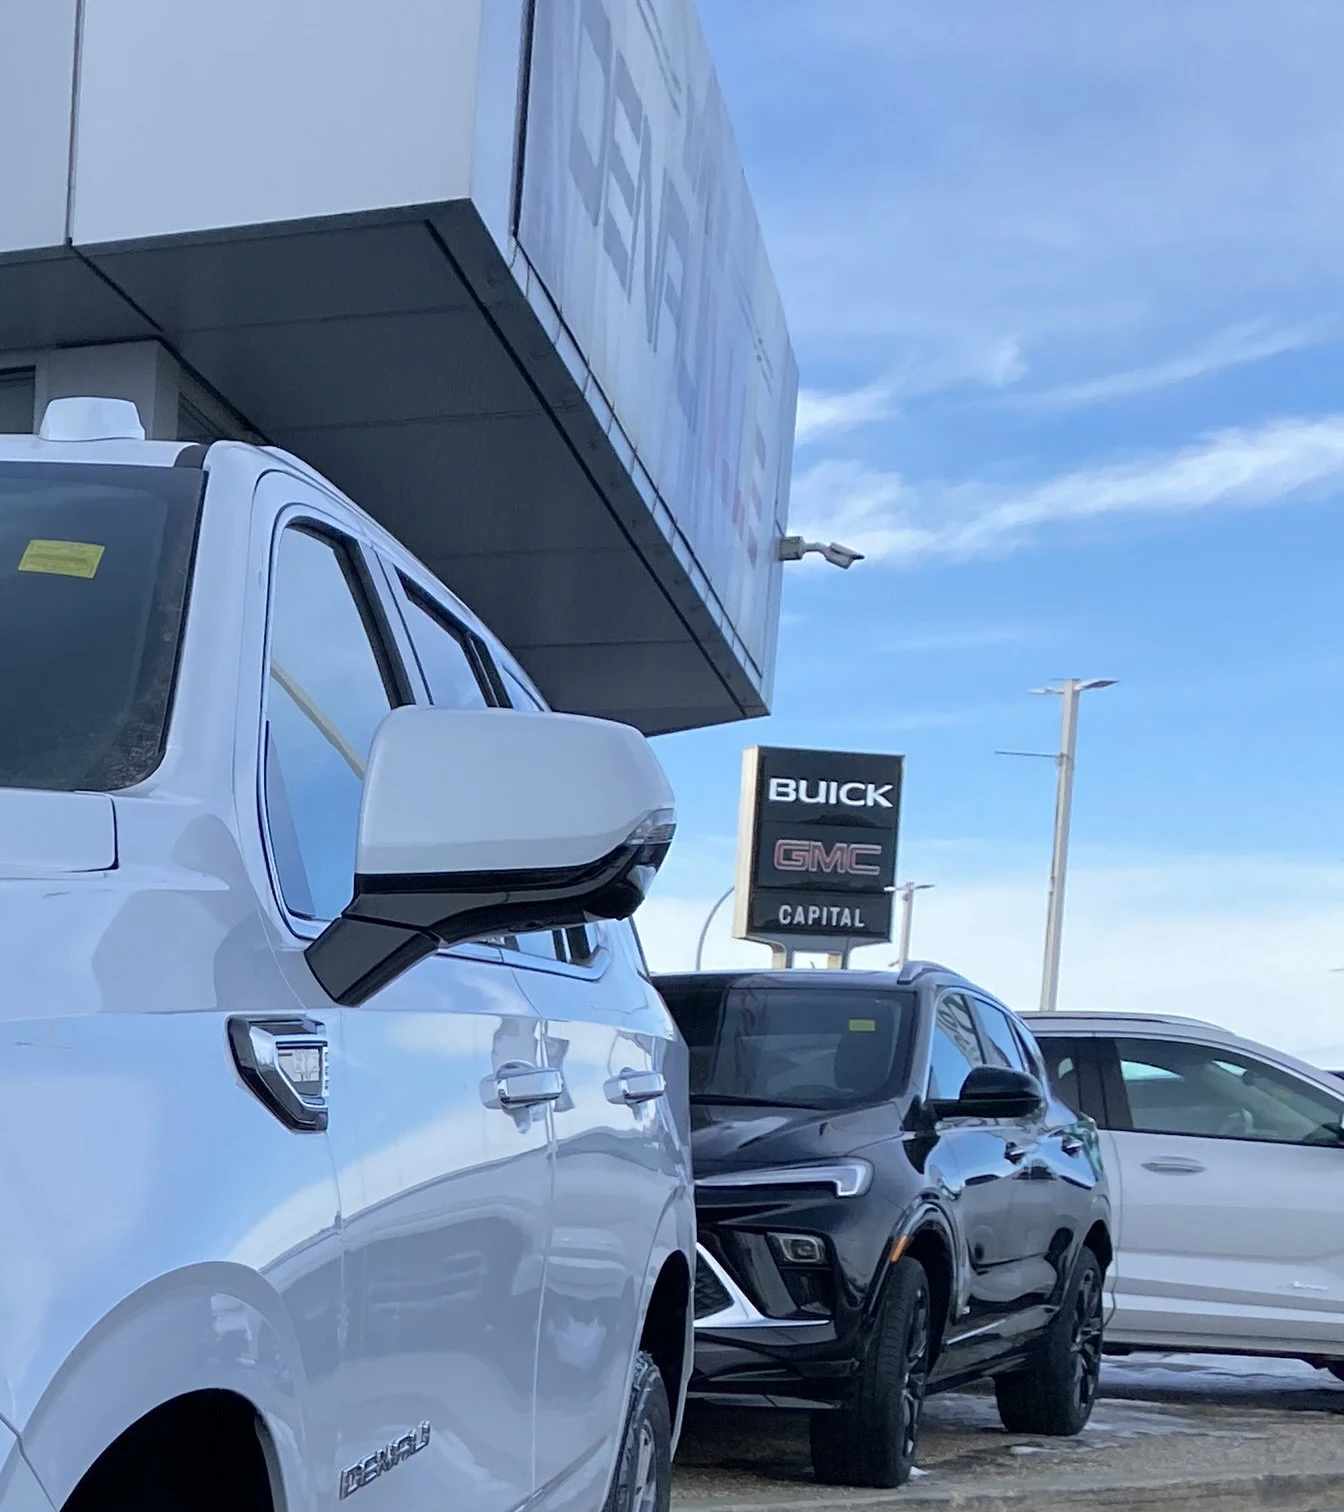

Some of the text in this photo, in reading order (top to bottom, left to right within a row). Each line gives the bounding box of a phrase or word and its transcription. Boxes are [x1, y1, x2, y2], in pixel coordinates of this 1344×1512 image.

[768, 778, 894, 808] BUICK
[773, 839, 882, 876] GMC
[778, 904, 865, 928] CAPITAL
[339, 1420, 430, 1501] DENALI
